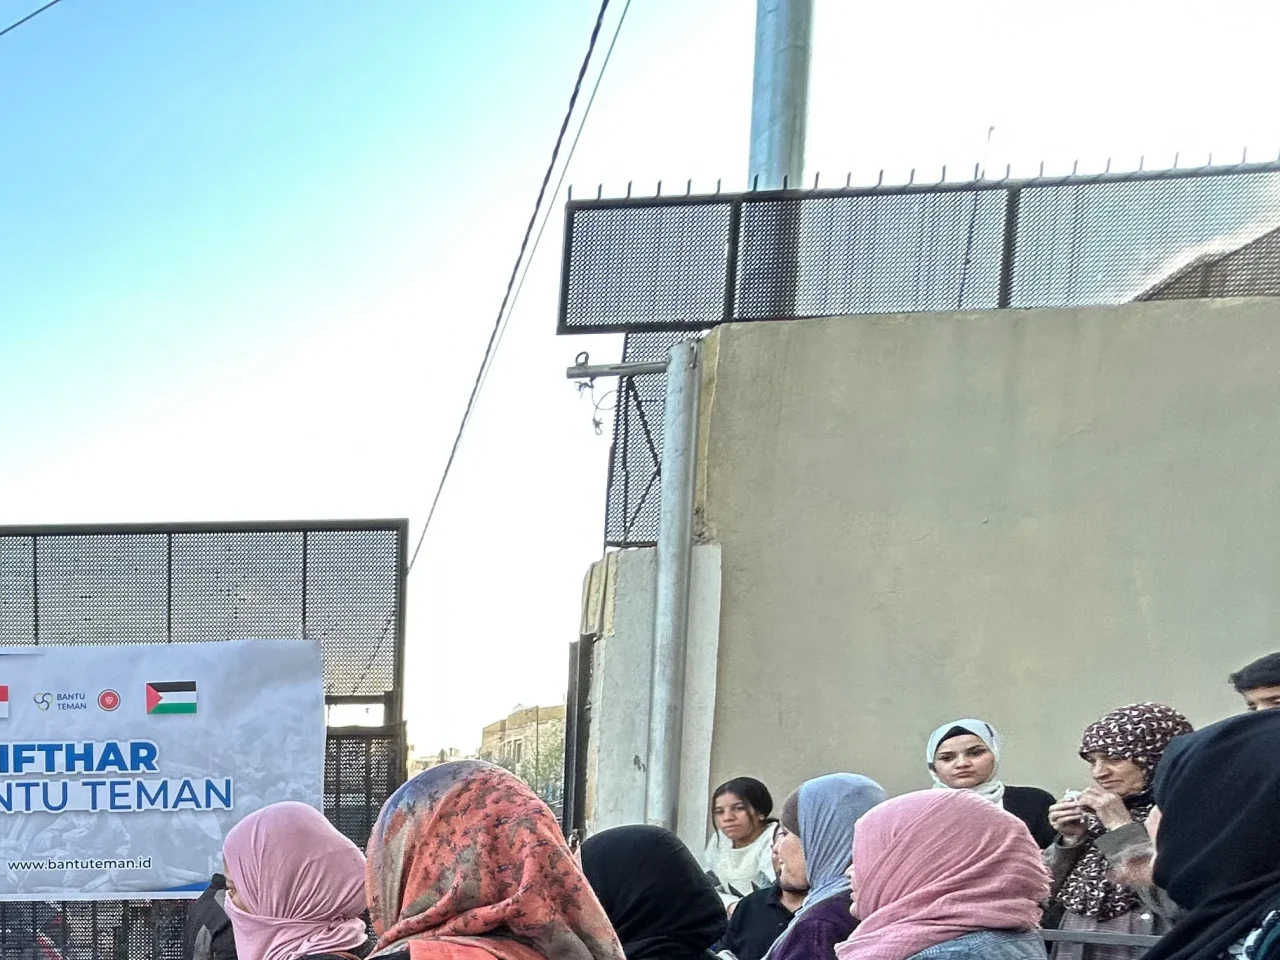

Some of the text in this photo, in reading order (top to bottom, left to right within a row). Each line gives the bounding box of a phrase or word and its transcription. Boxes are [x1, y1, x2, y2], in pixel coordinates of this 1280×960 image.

[56, 693, 86, 701] BANTU
[57, 702, 87, 711] TEMAN
[81, 778, 232, 811] TEMAN
[7, 857, 152, 871] www.bantuteman.id
